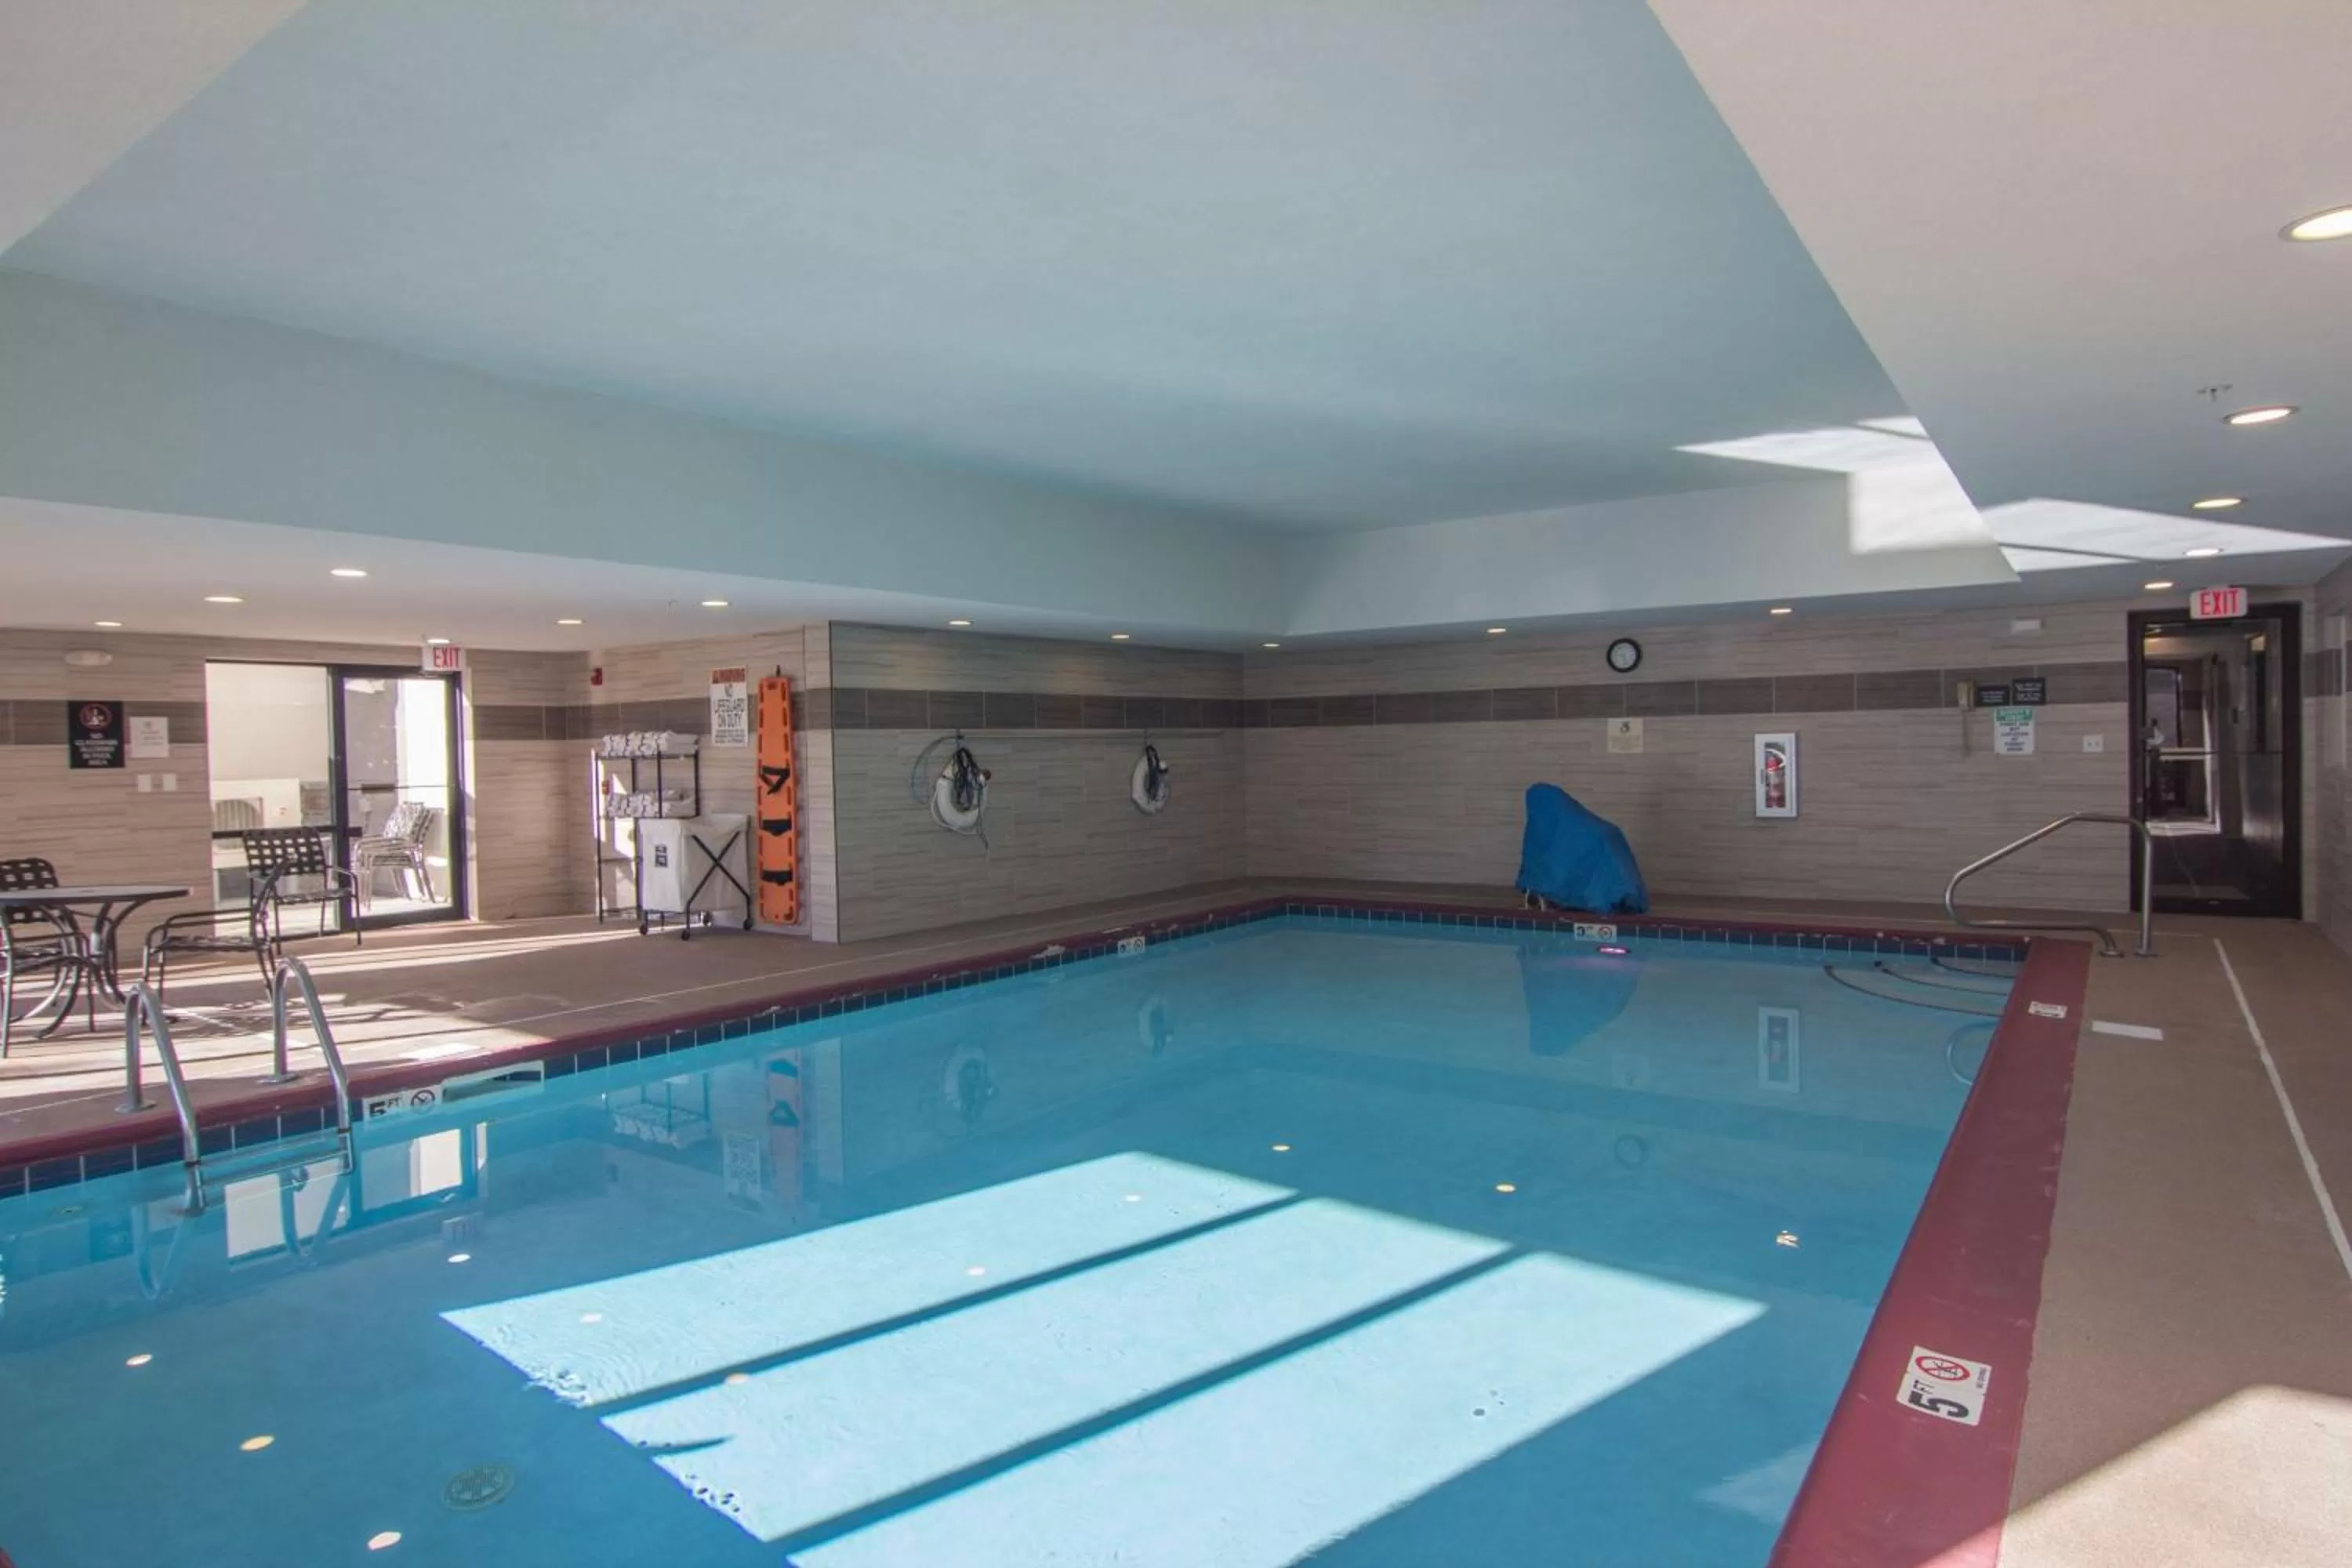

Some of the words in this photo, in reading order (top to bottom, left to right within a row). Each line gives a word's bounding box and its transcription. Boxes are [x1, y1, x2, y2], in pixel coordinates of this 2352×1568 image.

[2201, 589, 2239, 615] EXIT
[432, 647, 460, 668] EXIT
[369, 1101, 387, 1116] 5
[1907, 1390, 1969, 1418] 5
